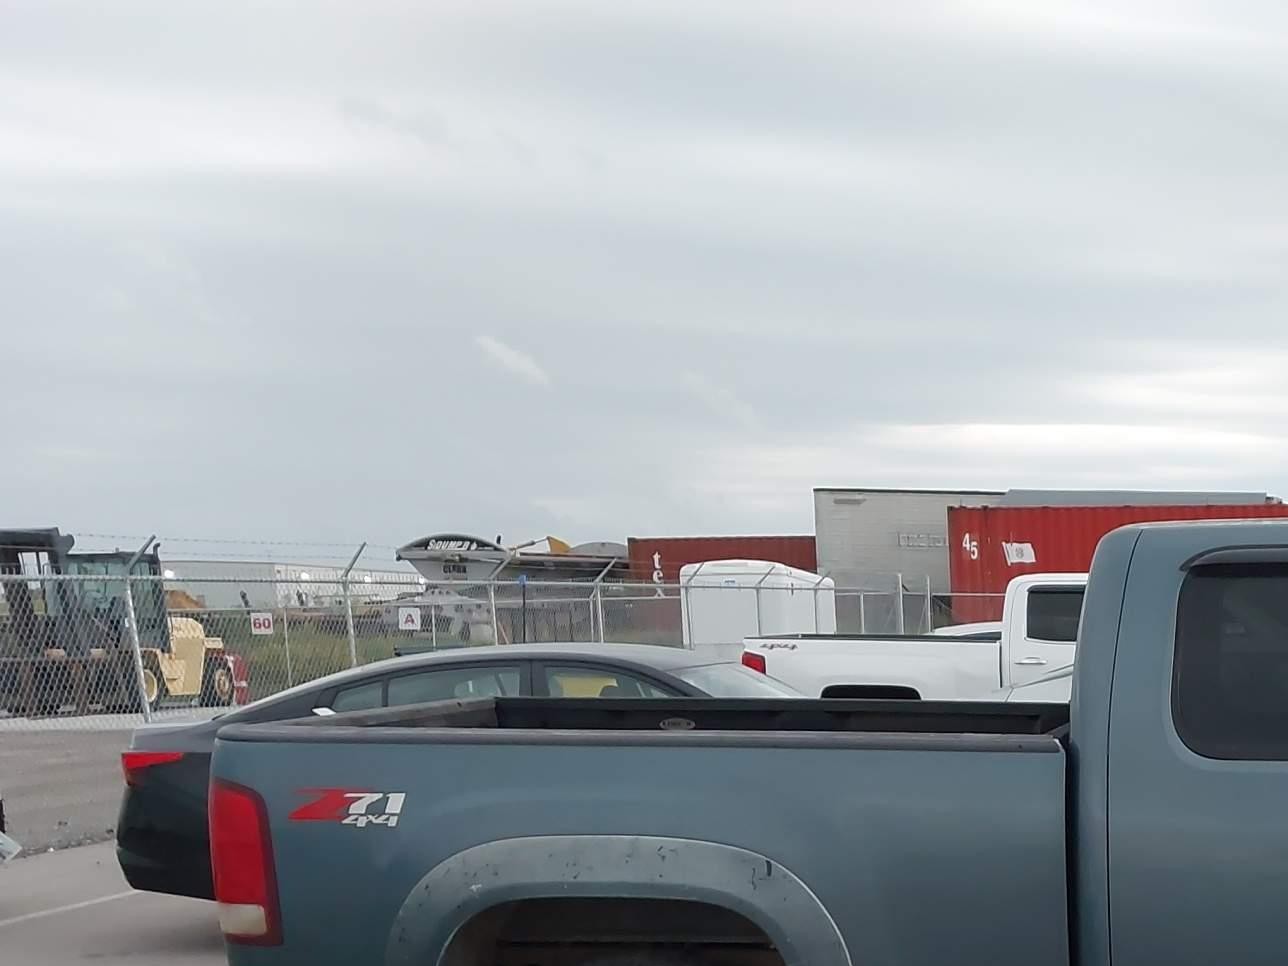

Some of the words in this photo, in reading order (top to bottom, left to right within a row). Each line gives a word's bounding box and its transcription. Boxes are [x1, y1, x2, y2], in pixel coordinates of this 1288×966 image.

[962, 533, 979, 560] 45
[253, 618, 271, 630] 60
[404, 614, 416, 625] A
[288, 788, 406, 820] Z71
